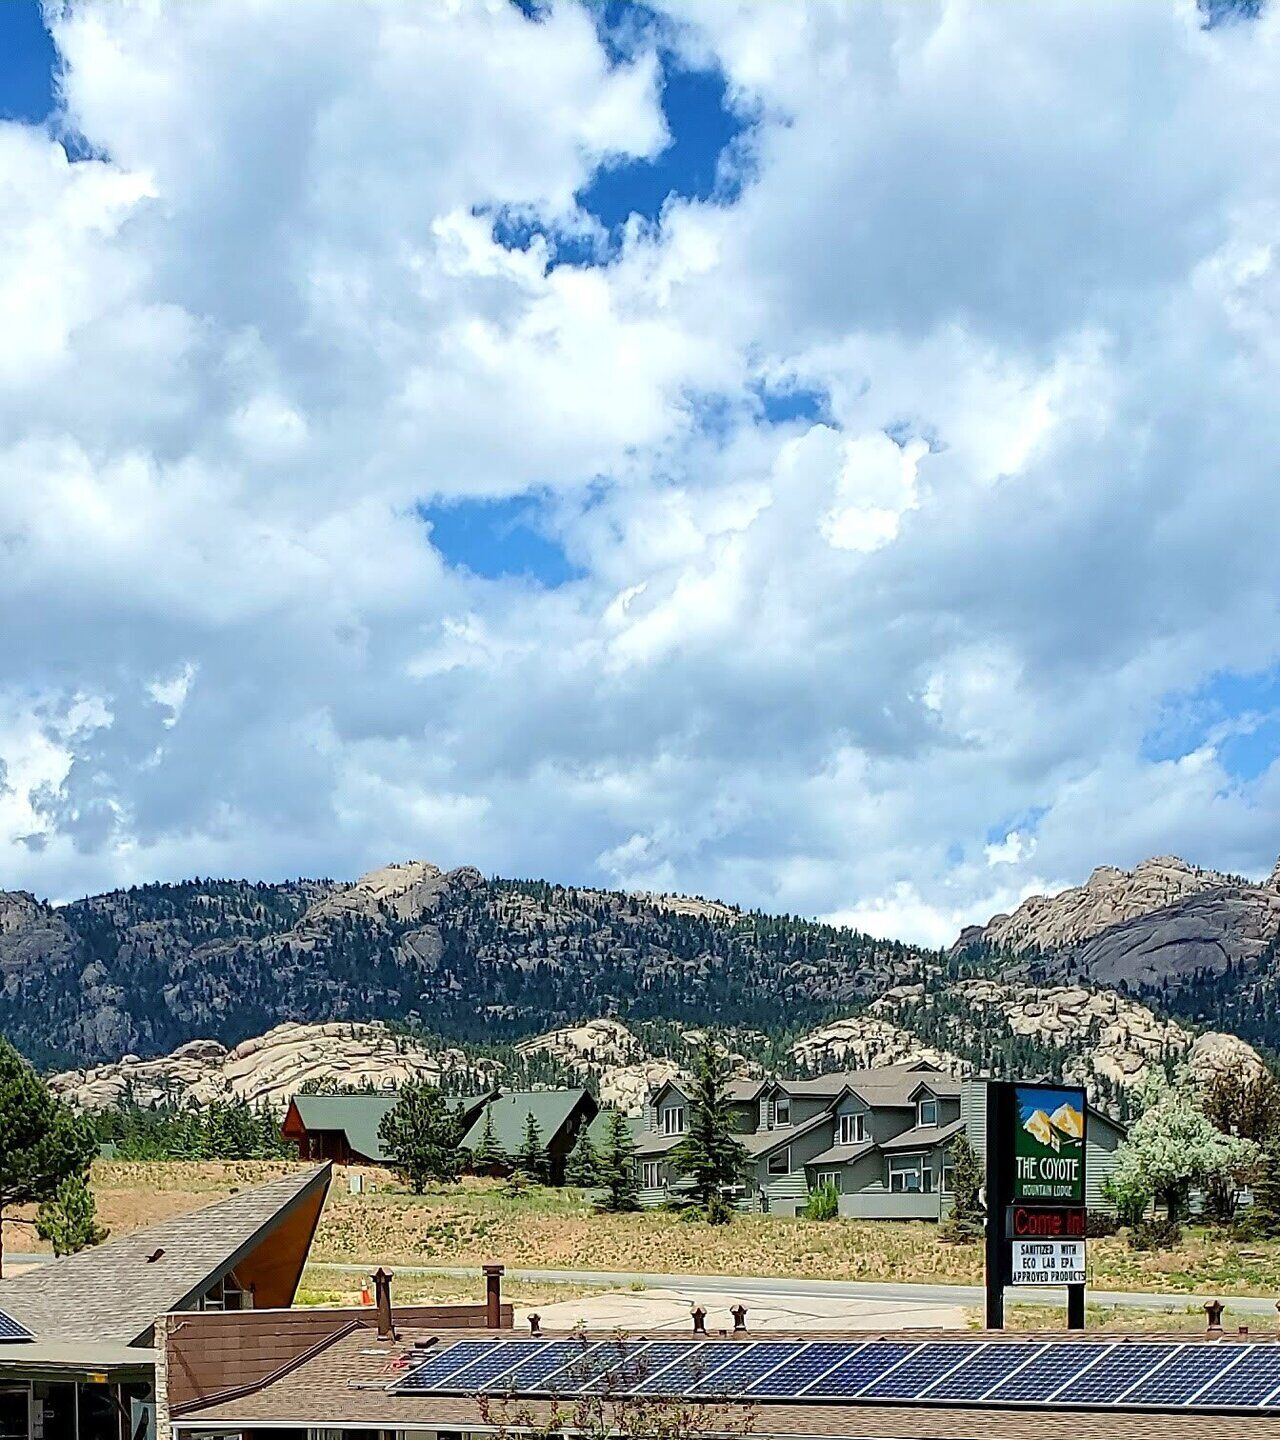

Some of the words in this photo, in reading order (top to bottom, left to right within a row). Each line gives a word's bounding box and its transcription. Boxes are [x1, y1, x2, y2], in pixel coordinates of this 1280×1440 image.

[1016, 1156, 1037, 1180] THE
[1040, 1157, 1079, 1181] COYOTE
[1016, 1208, 1061, 1234] Come
[1020, 1244, 1054, 1255] SANITIZED
[1060, 1244, 1077, 1255] WITH
[1022, 1257, 1036, 1269] ECO
[1042, 1257, 1056, 1269] LAB
[1061, 1257, 1074, 1269] EPA
[1013, 1270, 1048, 1282] APPROVED
[1050, 1270, 1086, 1282] PRODUCTS
